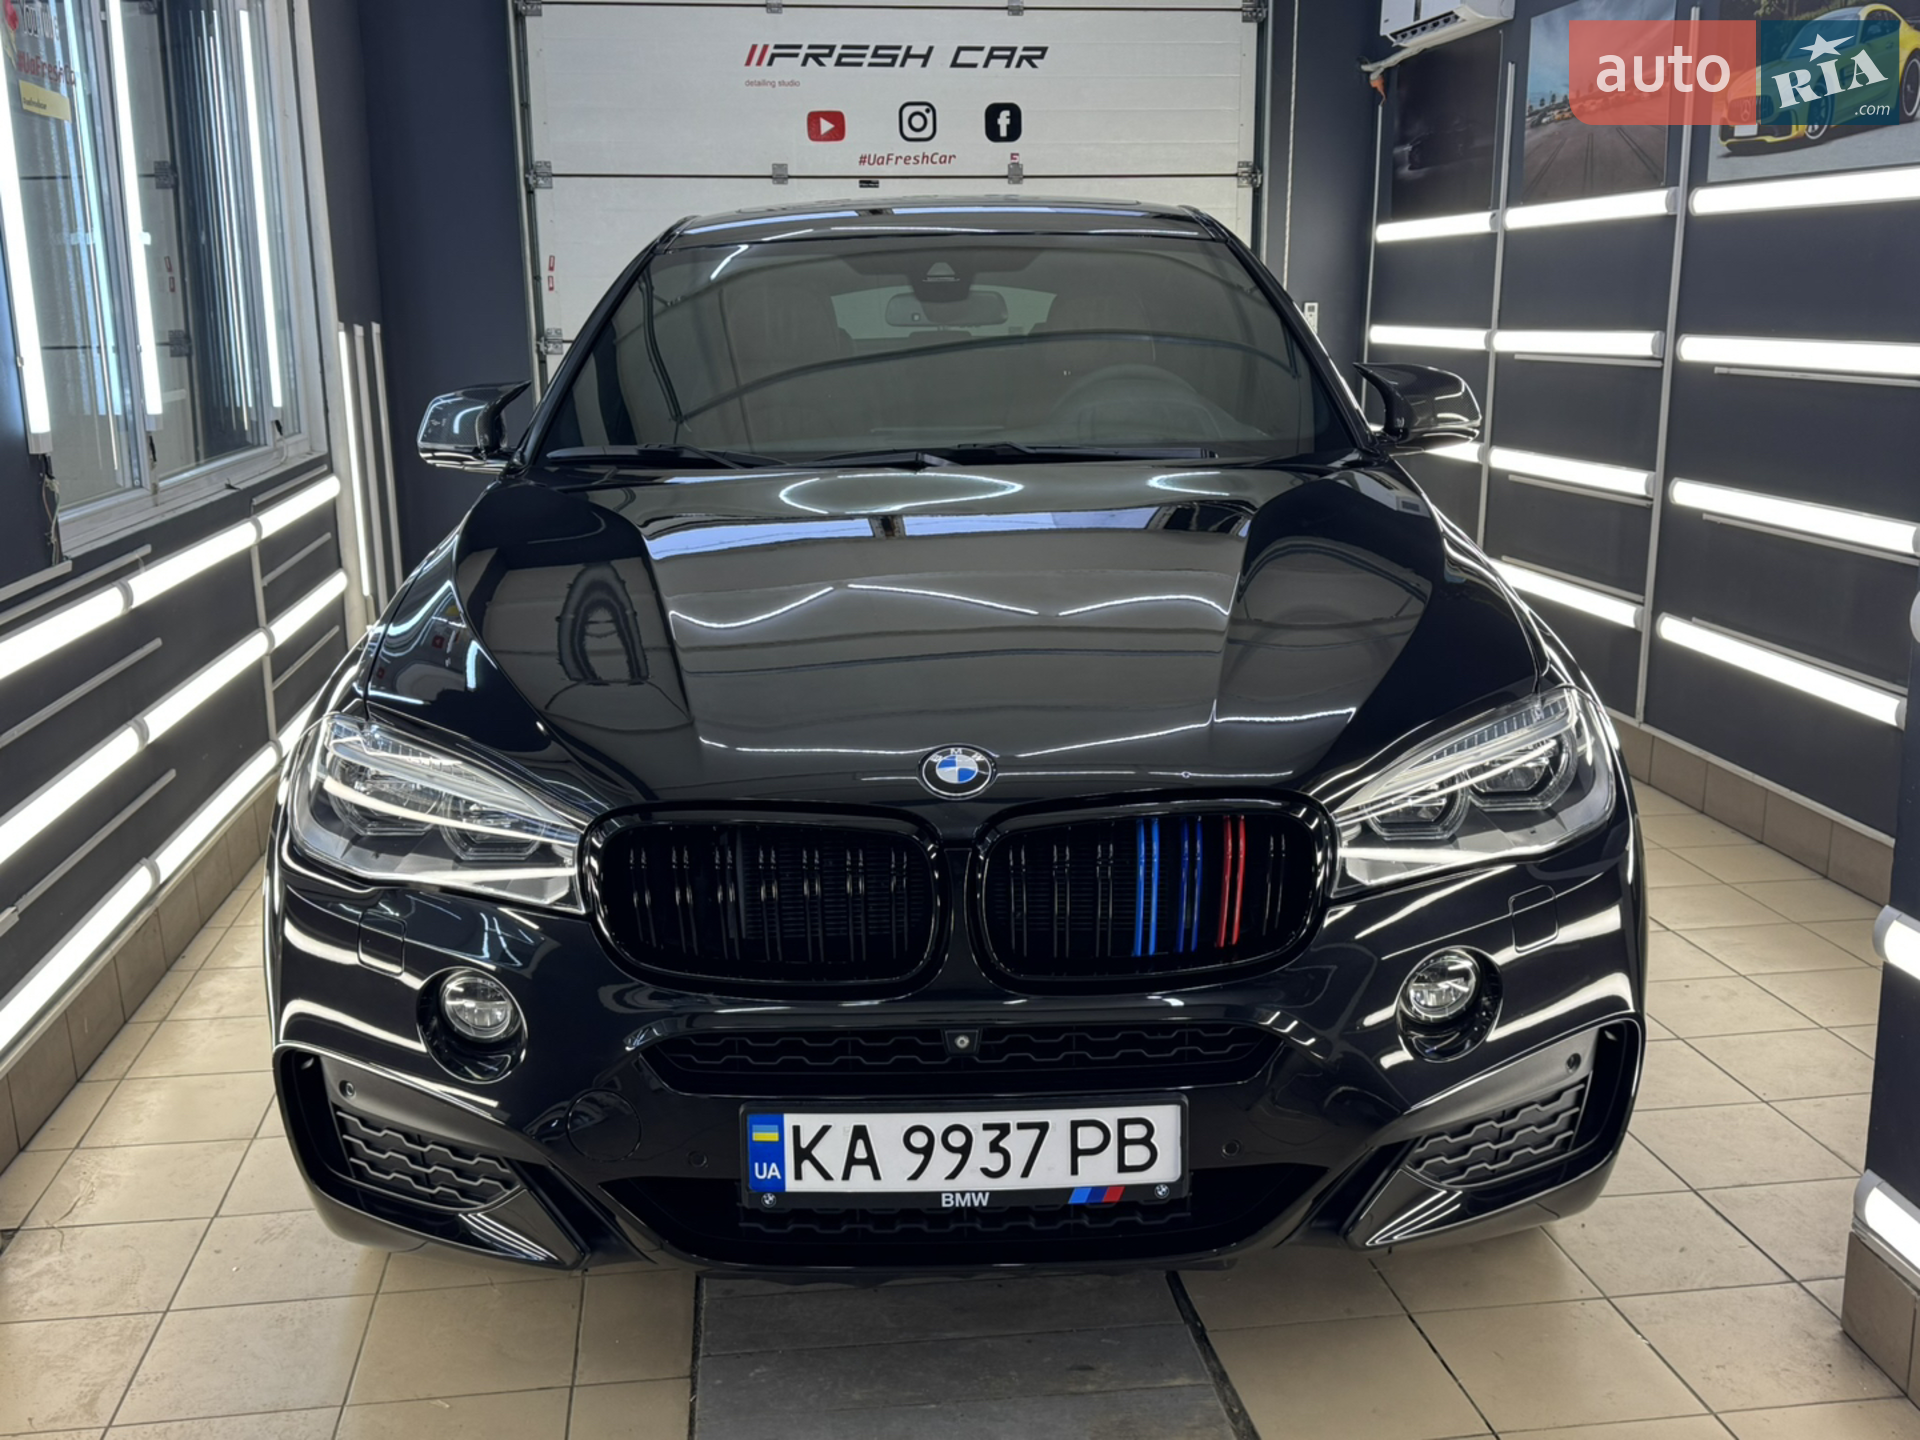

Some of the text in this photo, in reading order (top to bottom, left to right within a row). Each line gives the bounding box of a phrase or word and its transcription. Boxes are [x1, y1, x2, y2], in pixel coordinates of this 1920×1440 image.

[949, 46, 1049, 68] CAR
[744, 79, 801, 88] detailing studio
[858, 152, 957, 167] #UaFreshCar
[792, 1117, 1159, 1181] KA 9937 PB
[754, 1162, 782, 1180] UA
[941, 1192, 990, 1208] BMW
